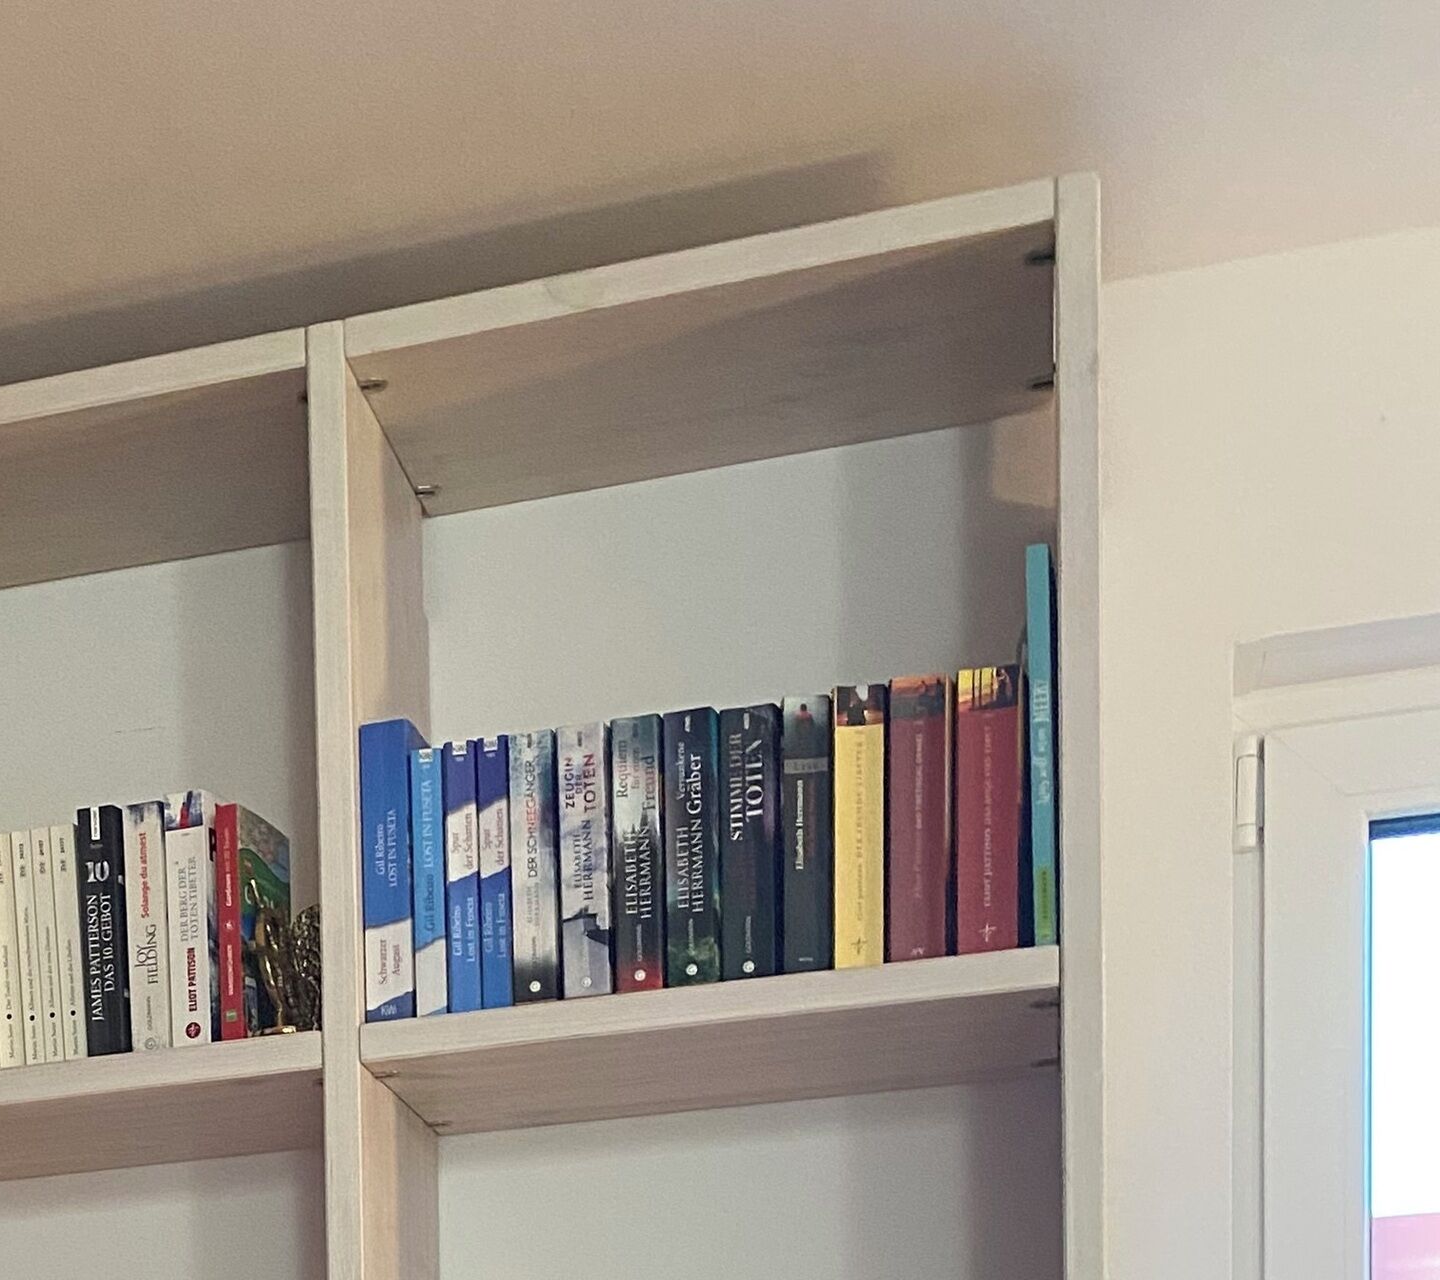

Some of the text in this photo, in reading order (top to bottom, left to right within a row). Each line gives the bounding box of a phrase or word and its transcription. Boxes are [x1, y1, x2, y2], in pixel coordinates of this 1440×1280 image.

[564, 757, 575, 809] ZEUGIN
[584, 753, 596, 813] TOTEN
[615, 740, 629, 798] Requiem
[642, 755, 656, 810] Freund
[686, 754, 703, 814] Gräber
[744, 739, 764, 823] TOTEN
[387, 809, 397, 847] FUSETA
[388, 863, 397, 887] LOST
[582, 819, 593, 900] HERRMANN
[638, 825, 651, 918] HERRMANN
[677, 827, 690, 908] ELISABETH
[690, 819, 704, 912] HERRMANN
[139, 881, 149, 918] Solange
[87, 895, 104, 1020] JAMES PATTERSON
[100, 893, 115, 991] DAS 10. GEBOT
[134, 945, 147, 966] JOY
[142, 925, 158, 984] FIELDING
[186, 947, 197, 1011] ELIOT PATTISON
